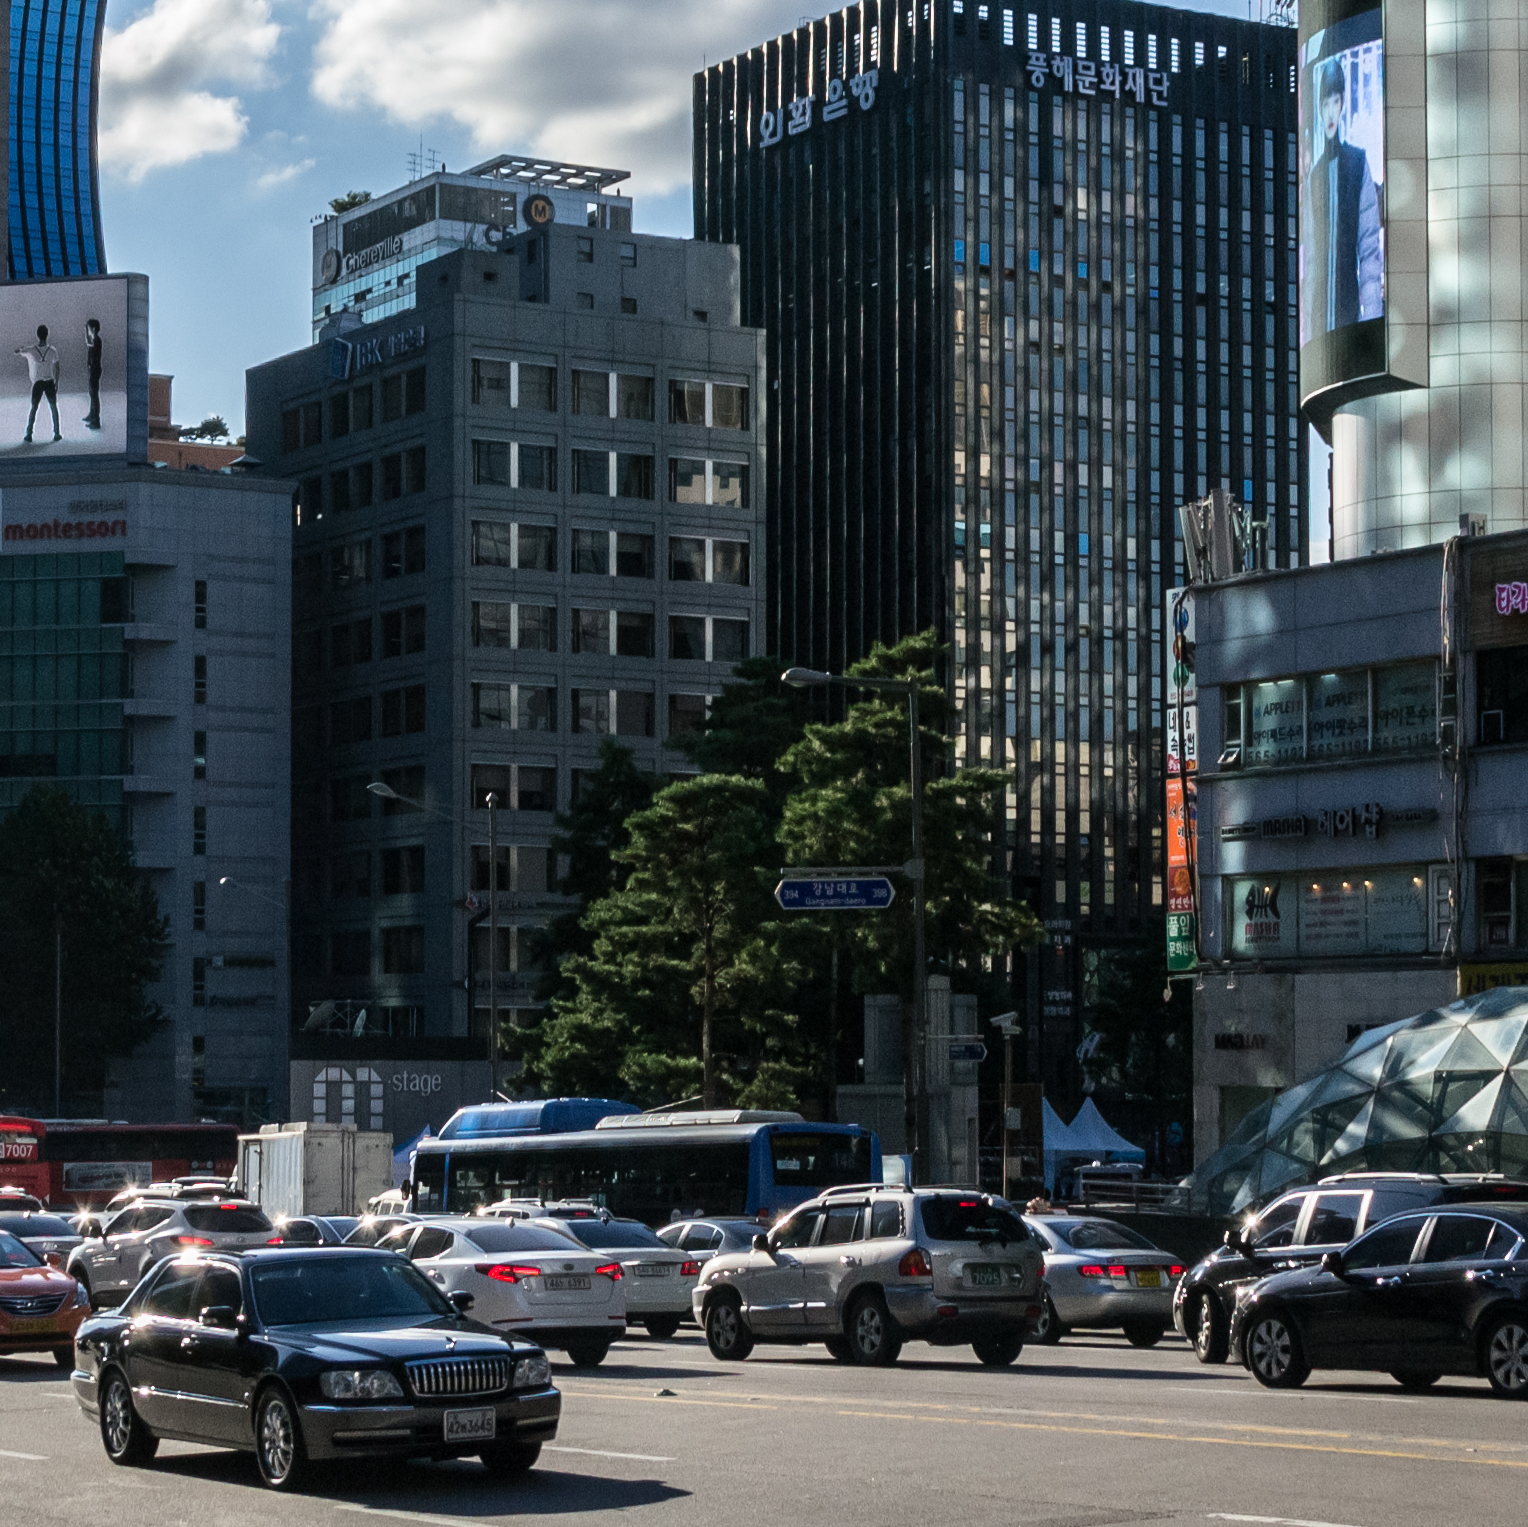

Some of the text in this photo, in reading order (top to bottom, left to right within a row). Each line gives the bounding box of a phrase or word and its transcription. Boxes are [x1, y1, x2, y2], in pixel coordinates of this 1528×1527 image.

[1025, 50, 1171, 108] 풍해문화재단
[759, 70, 879, 150] 외환은행
[344, 235, 403, 275] Chereville
[3, 517, 128, 542] montessori
[812, 880, 860, 898] 강남대로
[1168, 914, 1191, 938] 풀잎
[5, 1143, 34, 1159] 7007
